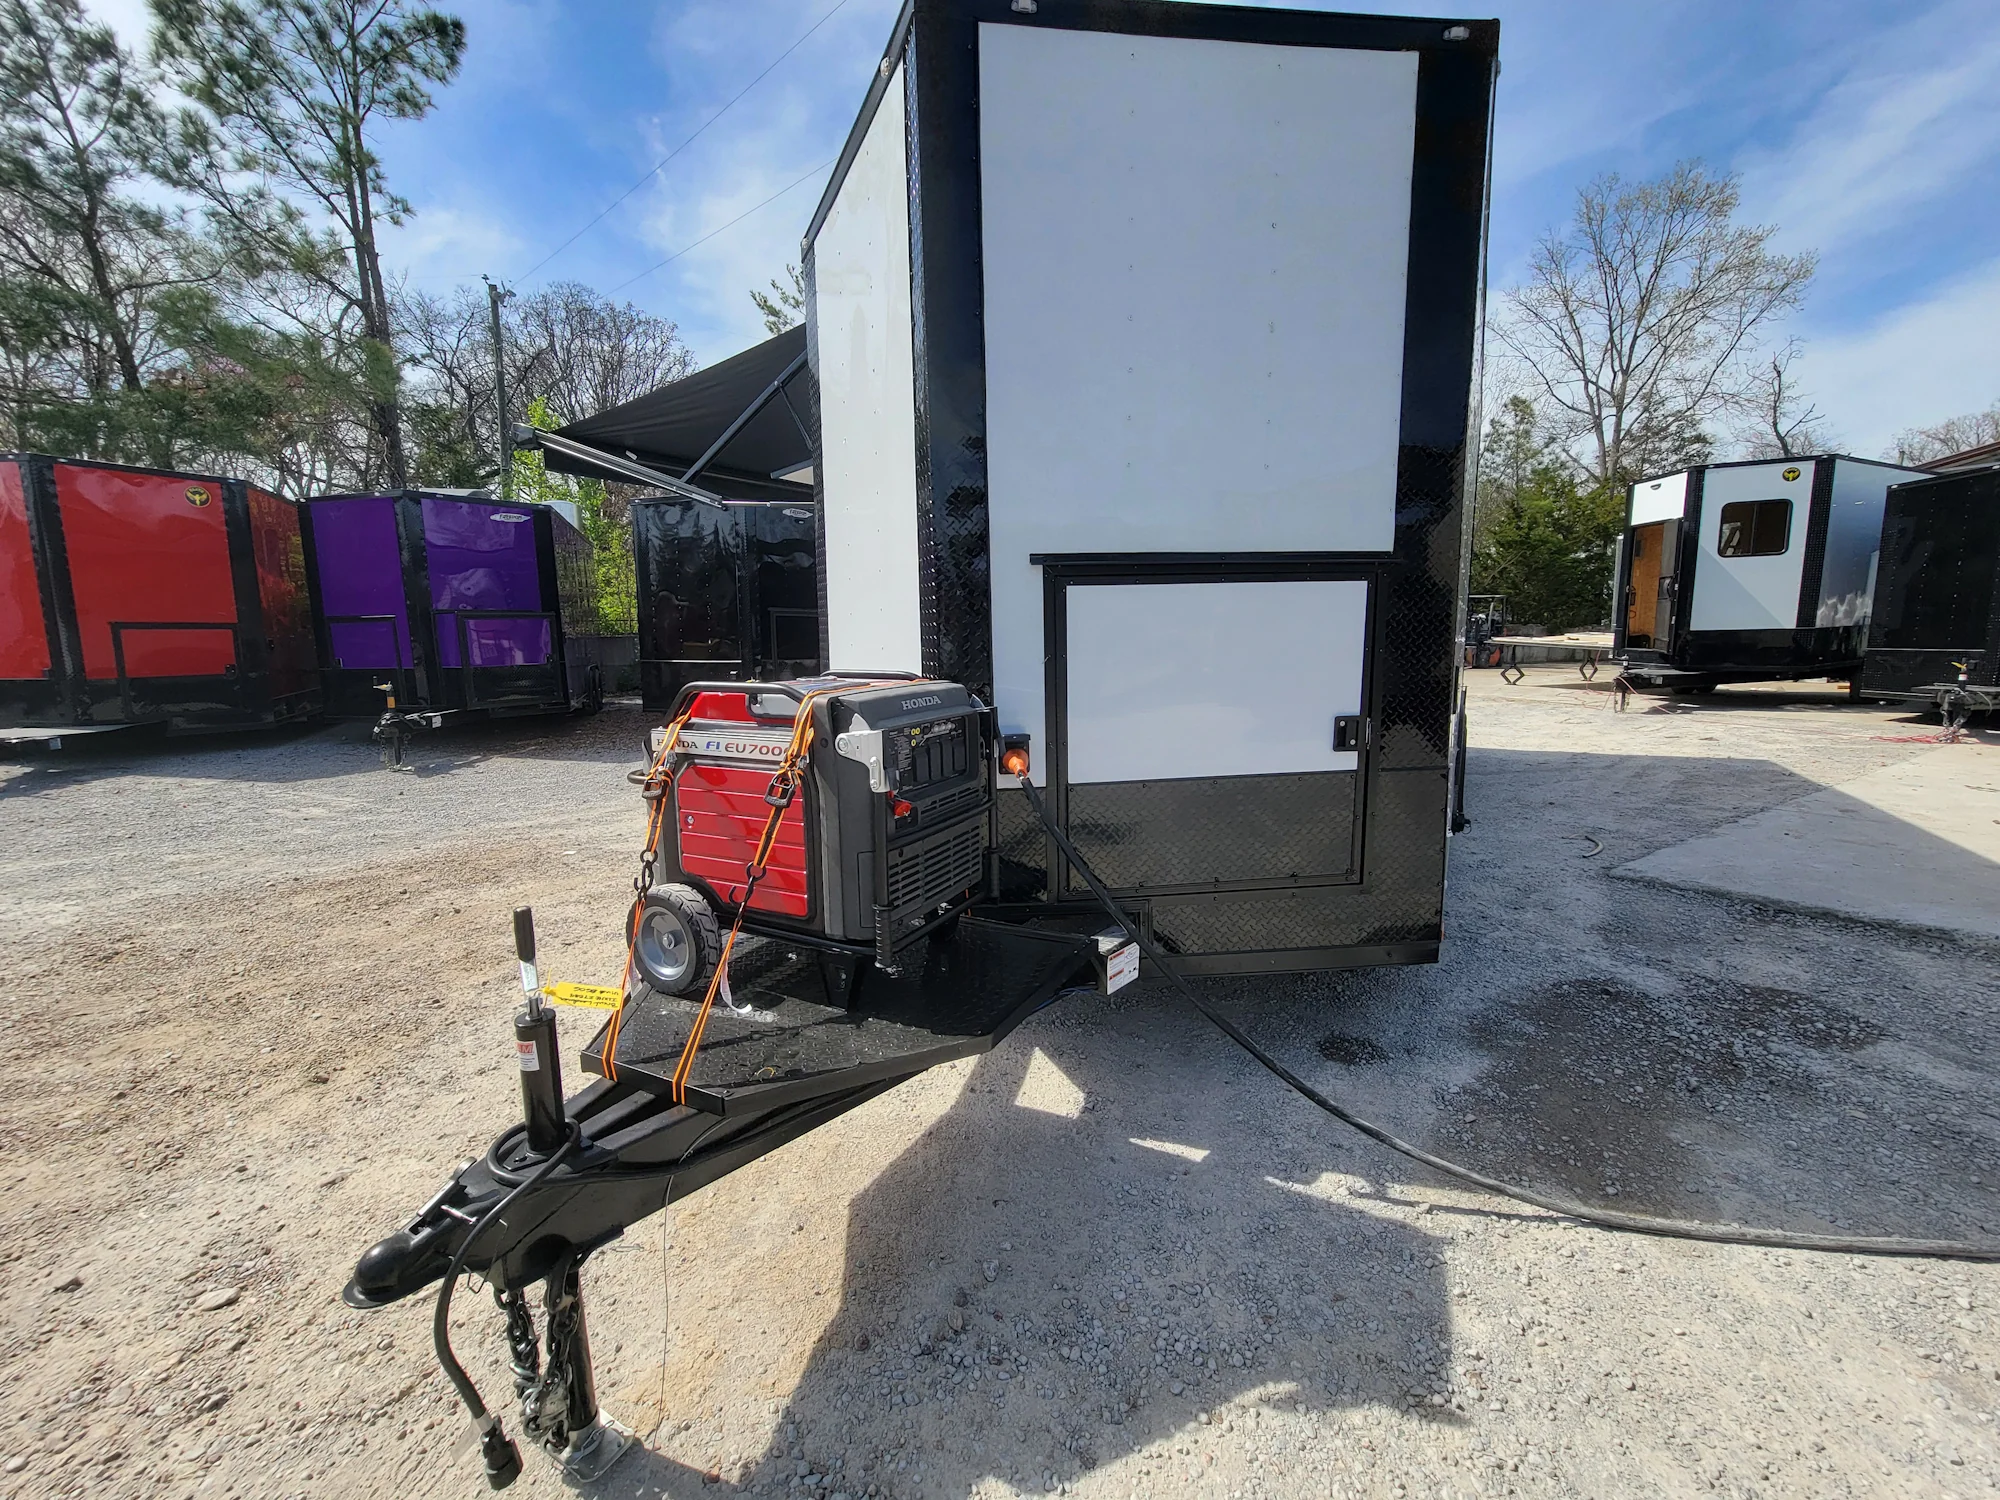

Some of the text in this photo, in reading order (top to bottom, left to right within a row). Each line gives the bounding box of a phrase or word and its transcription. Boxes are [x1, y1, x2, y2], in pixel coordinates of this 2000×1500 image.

[901, 695, 942, 711] HONDA
[656, 738, 698, 749] HNDA
[724, 743, 792, 757] EU700
